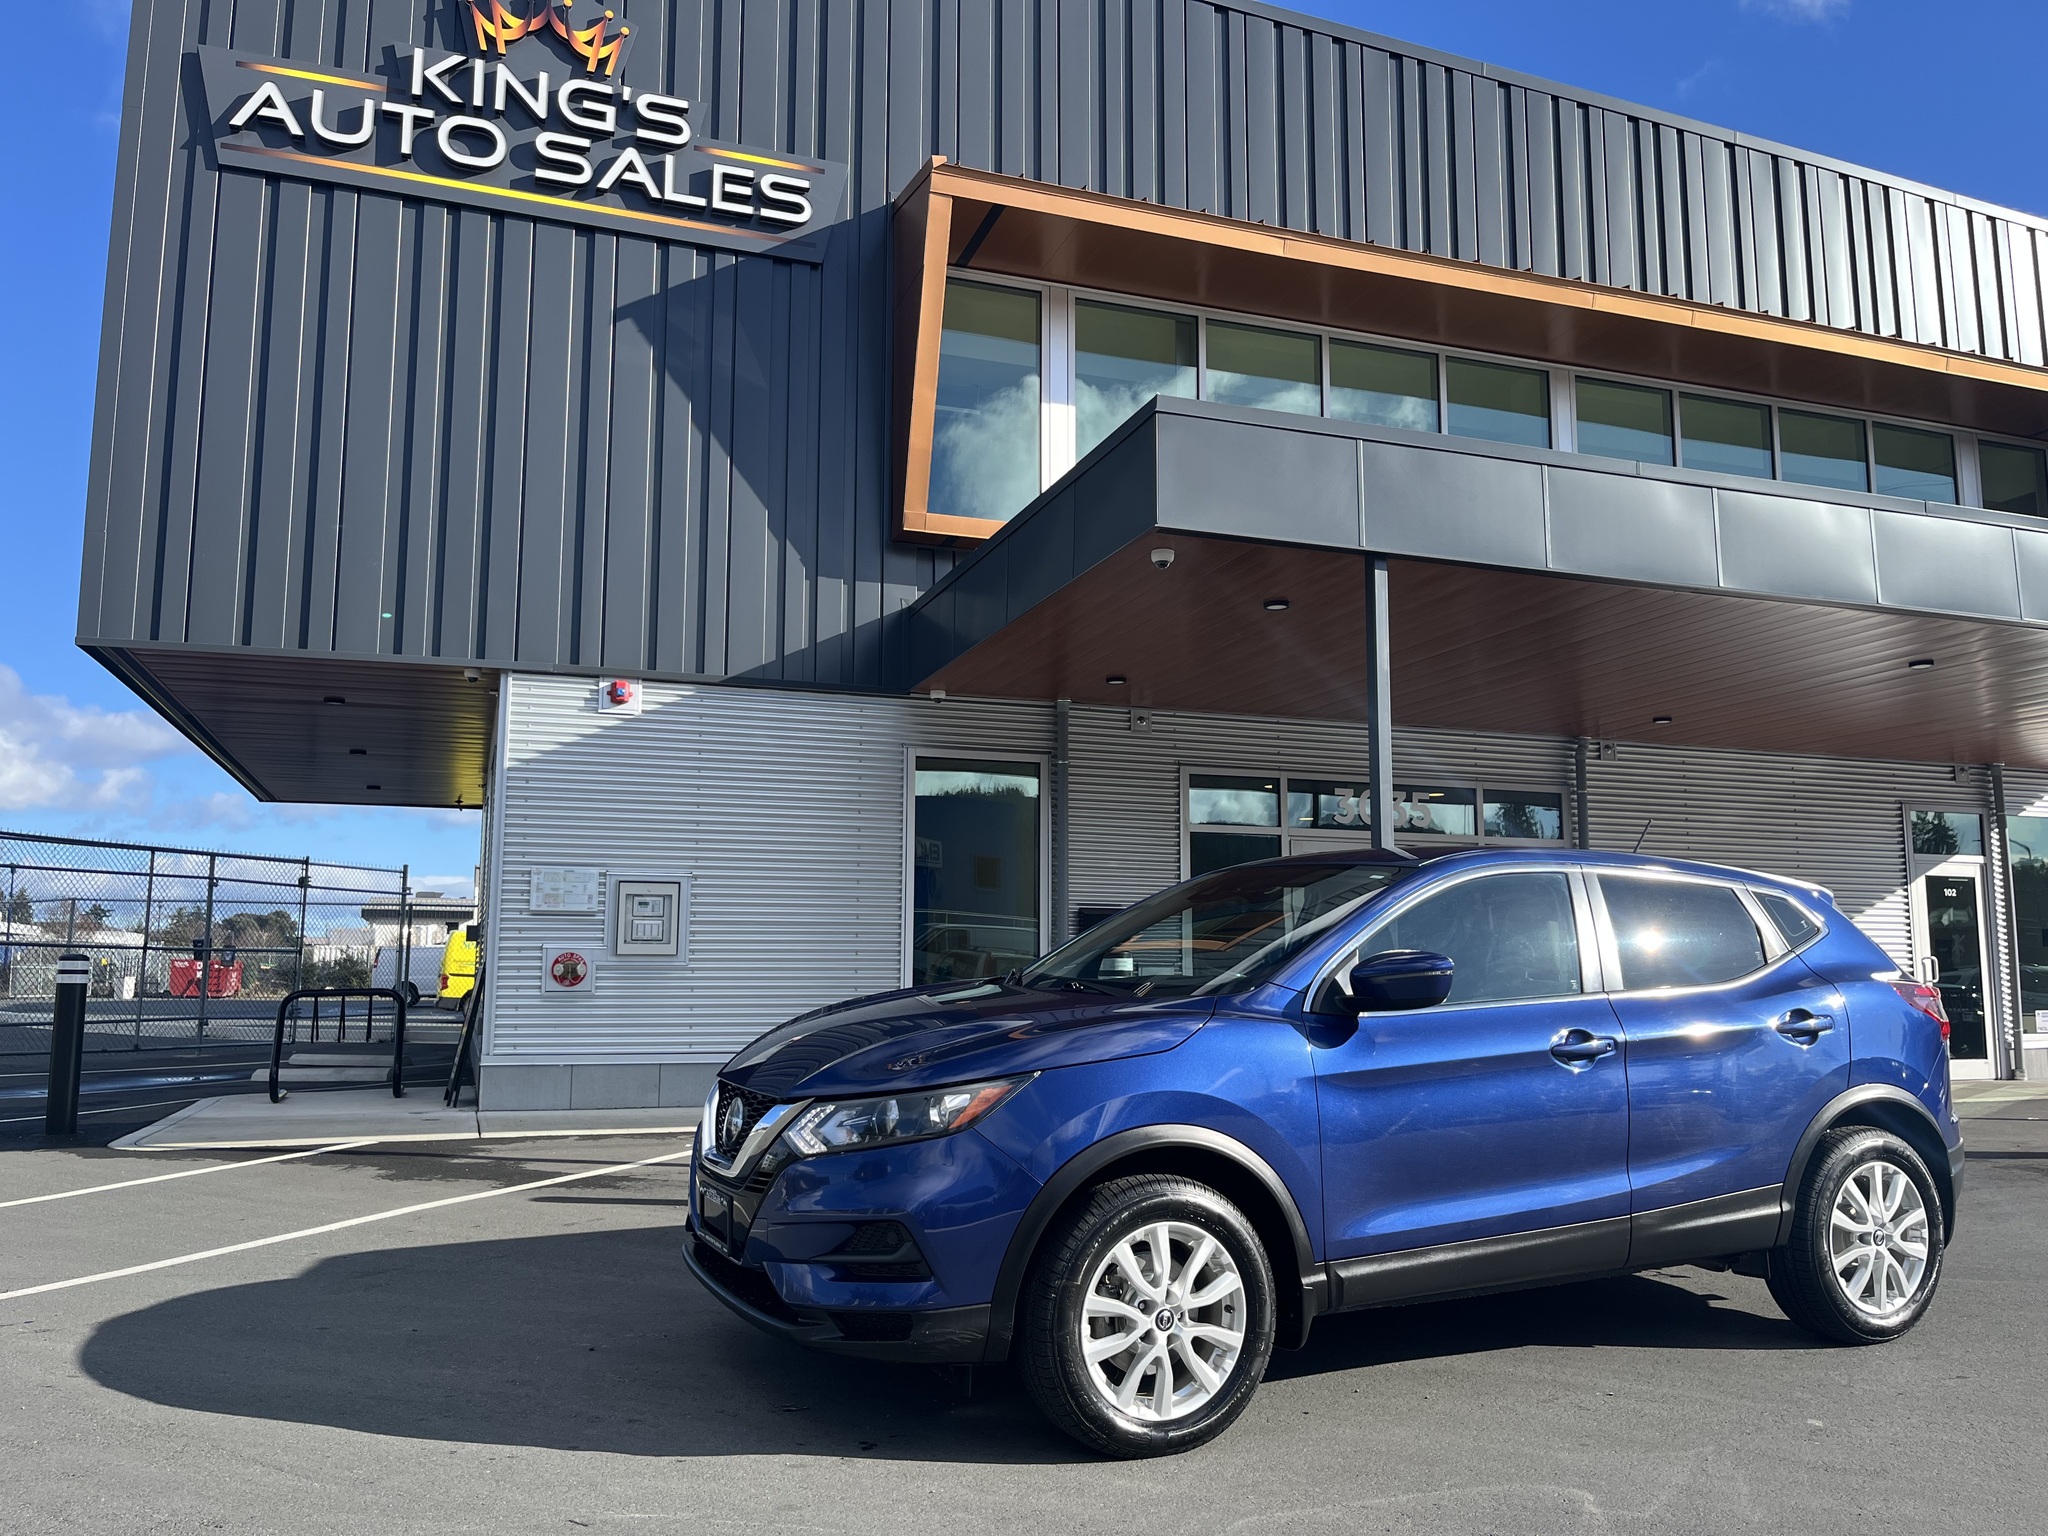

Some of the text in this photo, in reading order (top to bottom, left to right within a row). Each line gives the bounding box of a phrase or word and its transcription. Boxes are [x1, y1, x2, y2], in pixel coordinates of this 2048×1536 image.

[410, 47, 692, 146] KING'S
[229, 81, 813, 224] AUTO SALES
[1943, 888, 1957, 897] 102
